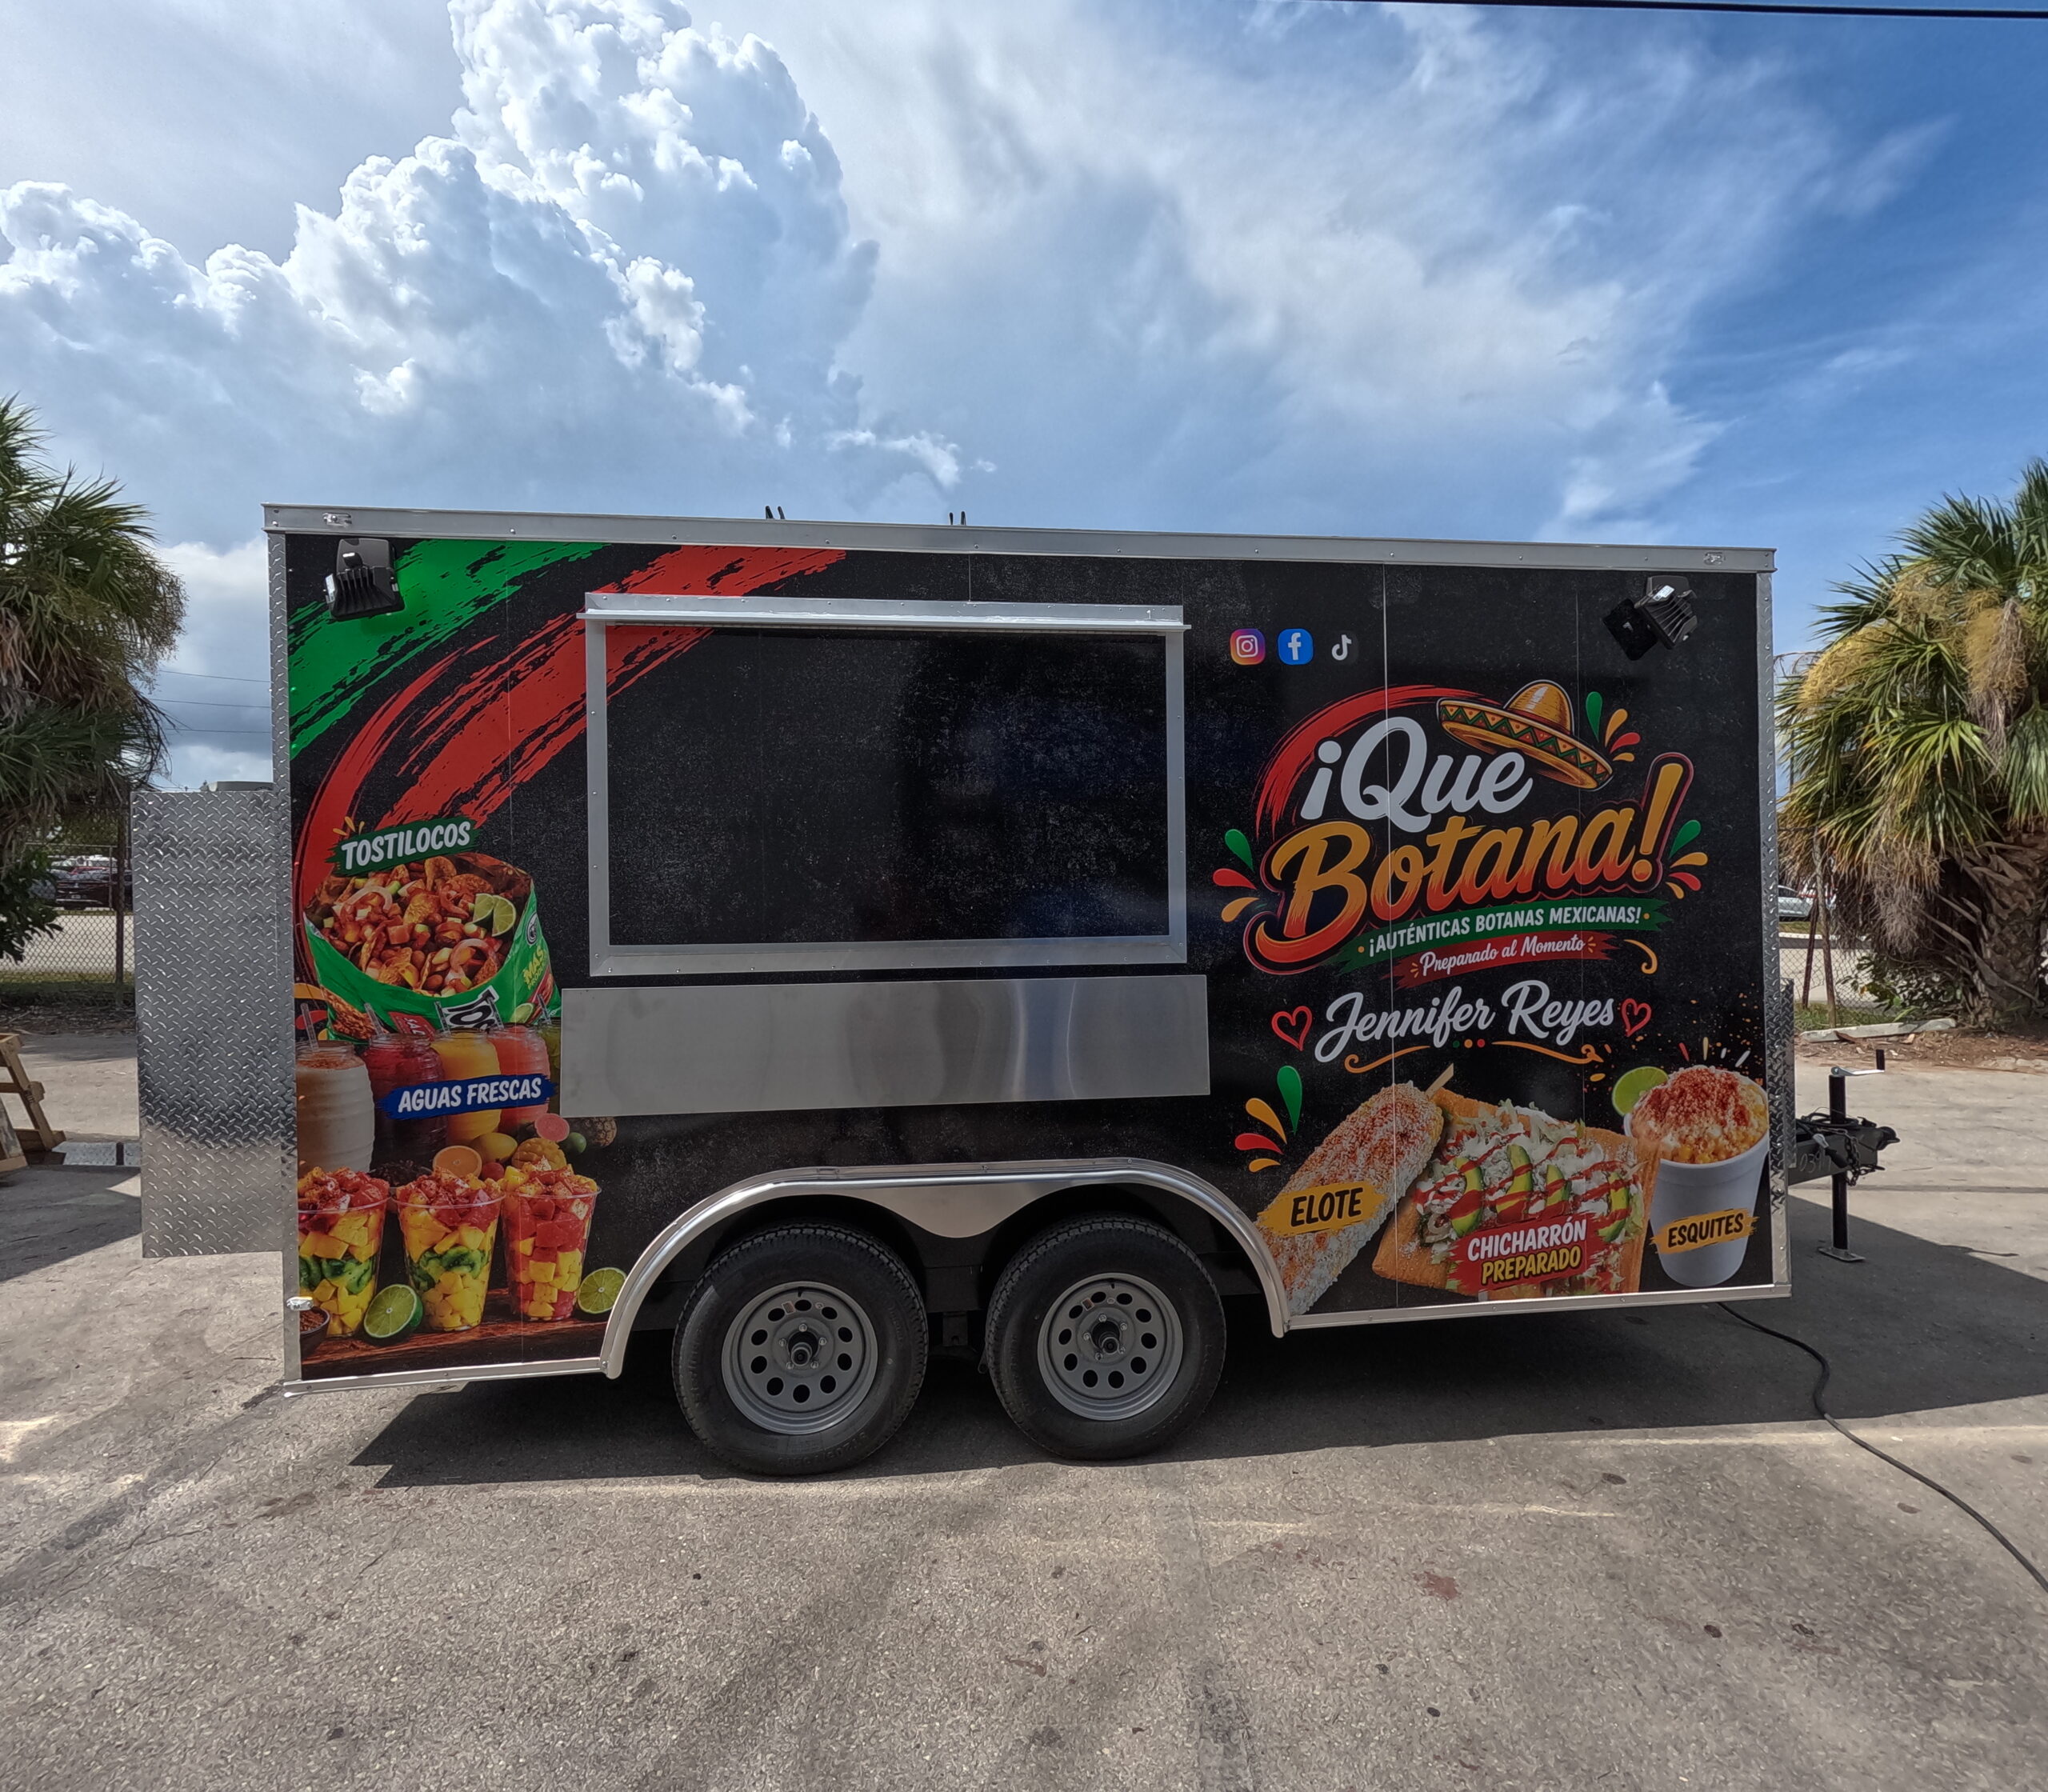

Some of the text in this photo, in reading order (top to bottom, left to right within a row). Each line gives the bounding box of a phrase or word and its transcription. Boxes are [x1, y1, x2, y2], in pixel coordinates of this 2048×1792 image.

[341, 821, 472, 870] TOSTILOCOS
[1256, 762, 1684, 963] Botana!
[1369, 905, 1642, 958] ¡AUTÉNTICAS BOTANAS MEXICANAS!
[1418, 934, 1586, 978] Preparado al Momento
[1314, 979, 1614, 1062] Jennifer Reyes
[398, 1078, 542, 1113] AGUAS FRESCAS
[1291, 1187, 1363, 1226] ELOTE
[1467, 1219, 1587, 1262] CHICHARRÓN
[1667, 1212, 1744, 1247] ESQUITES
[1482, 1247, 1582, 1284] PREPARADO
